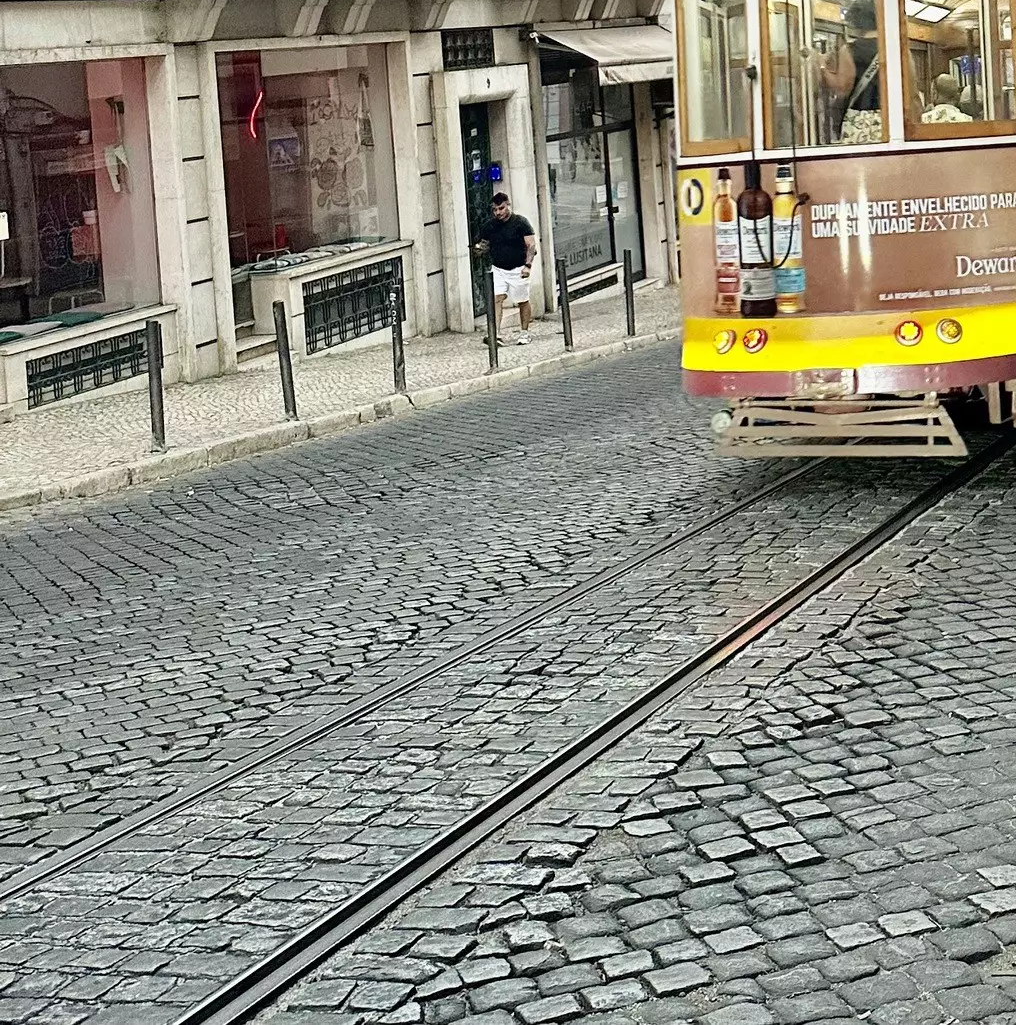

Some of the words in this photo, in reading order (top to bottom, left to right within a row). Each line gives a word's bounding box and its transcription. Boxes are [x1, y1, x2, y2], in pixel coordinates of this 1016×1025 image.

[811, 201, 898, 221] DUPLAMENTE
[902, 196, 988, 216] ENVELHECIDO
[812, 220, 839, 239] UMA
[845, 216, 916, 238] SUVIDADE
[918, 212, 989, 233] EXTRA
